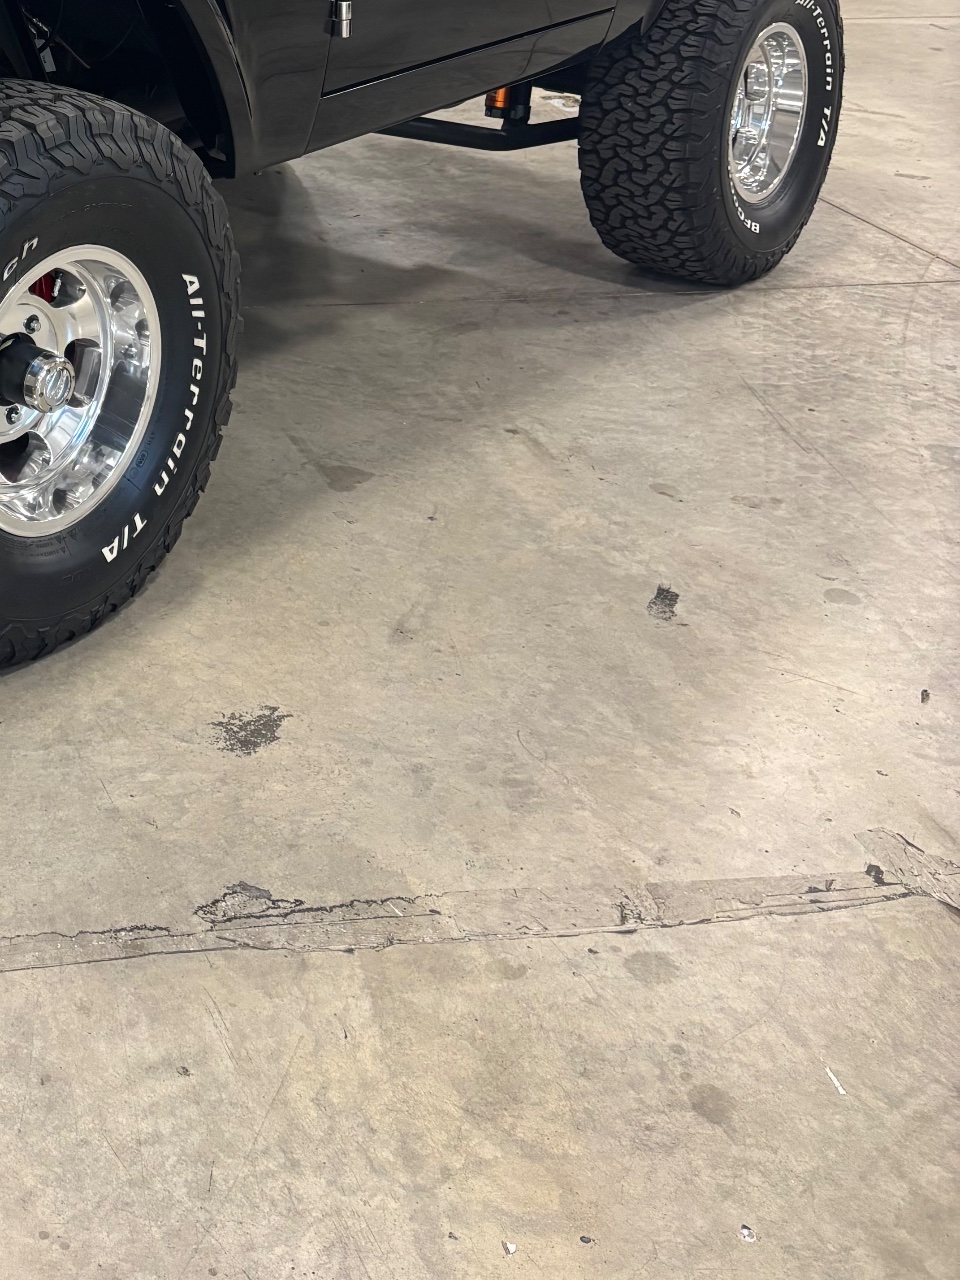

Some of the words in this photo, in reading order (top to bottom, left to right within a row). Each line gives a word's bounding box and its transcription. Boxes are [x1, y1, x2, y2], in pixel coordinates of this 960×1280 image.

[817, 106, 832, 147] T/A
[153, 274, 207, 496] All-Terrain
[101, 512, 147, 564] T/A
